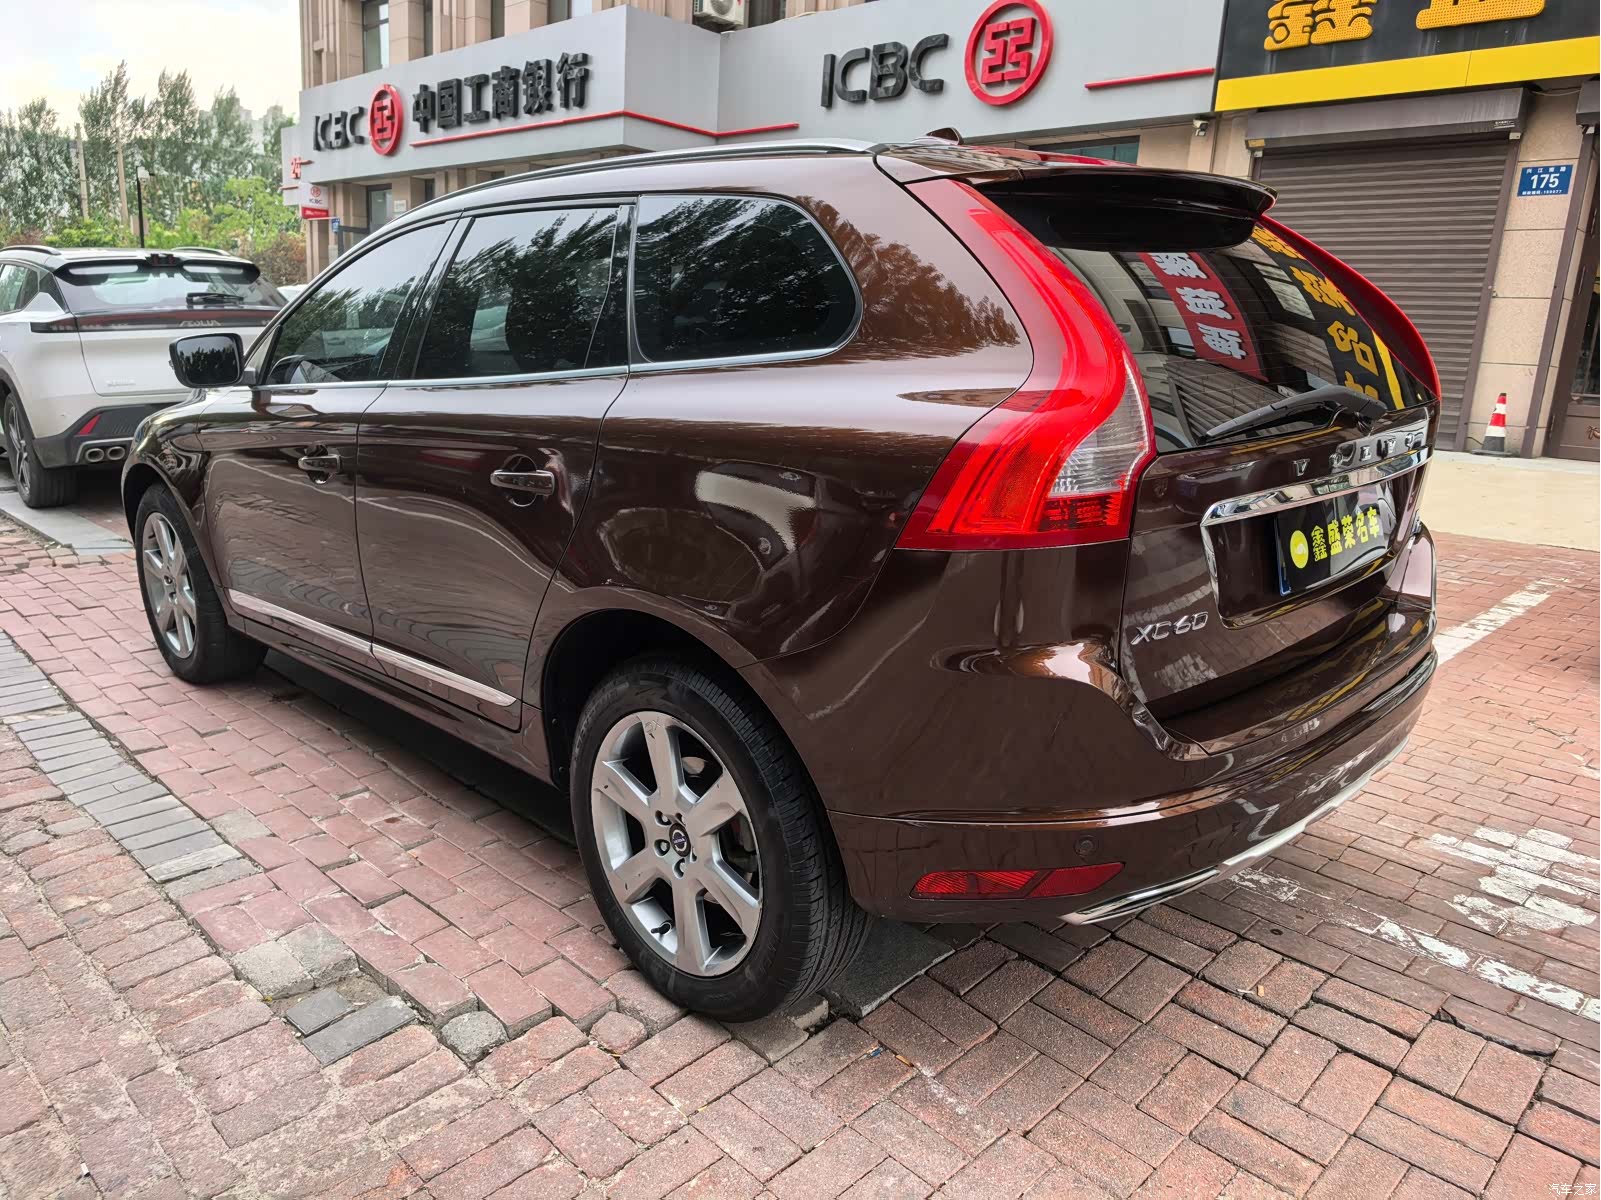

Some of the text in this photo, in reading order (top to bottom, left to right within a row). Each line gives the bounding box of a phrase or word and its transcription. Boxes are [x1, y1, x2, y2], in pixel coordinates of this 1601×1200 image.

[412, 52, 591, 133] 中国工商银行
[820, 33, 949, 109] ICBC
[312, 106, 367, 151] ICBC
[1530, 173, 1560, 189] 175
[1293, 432, 1415, 477] VOLVO
[1131, 611, 1209, 646] XC60
